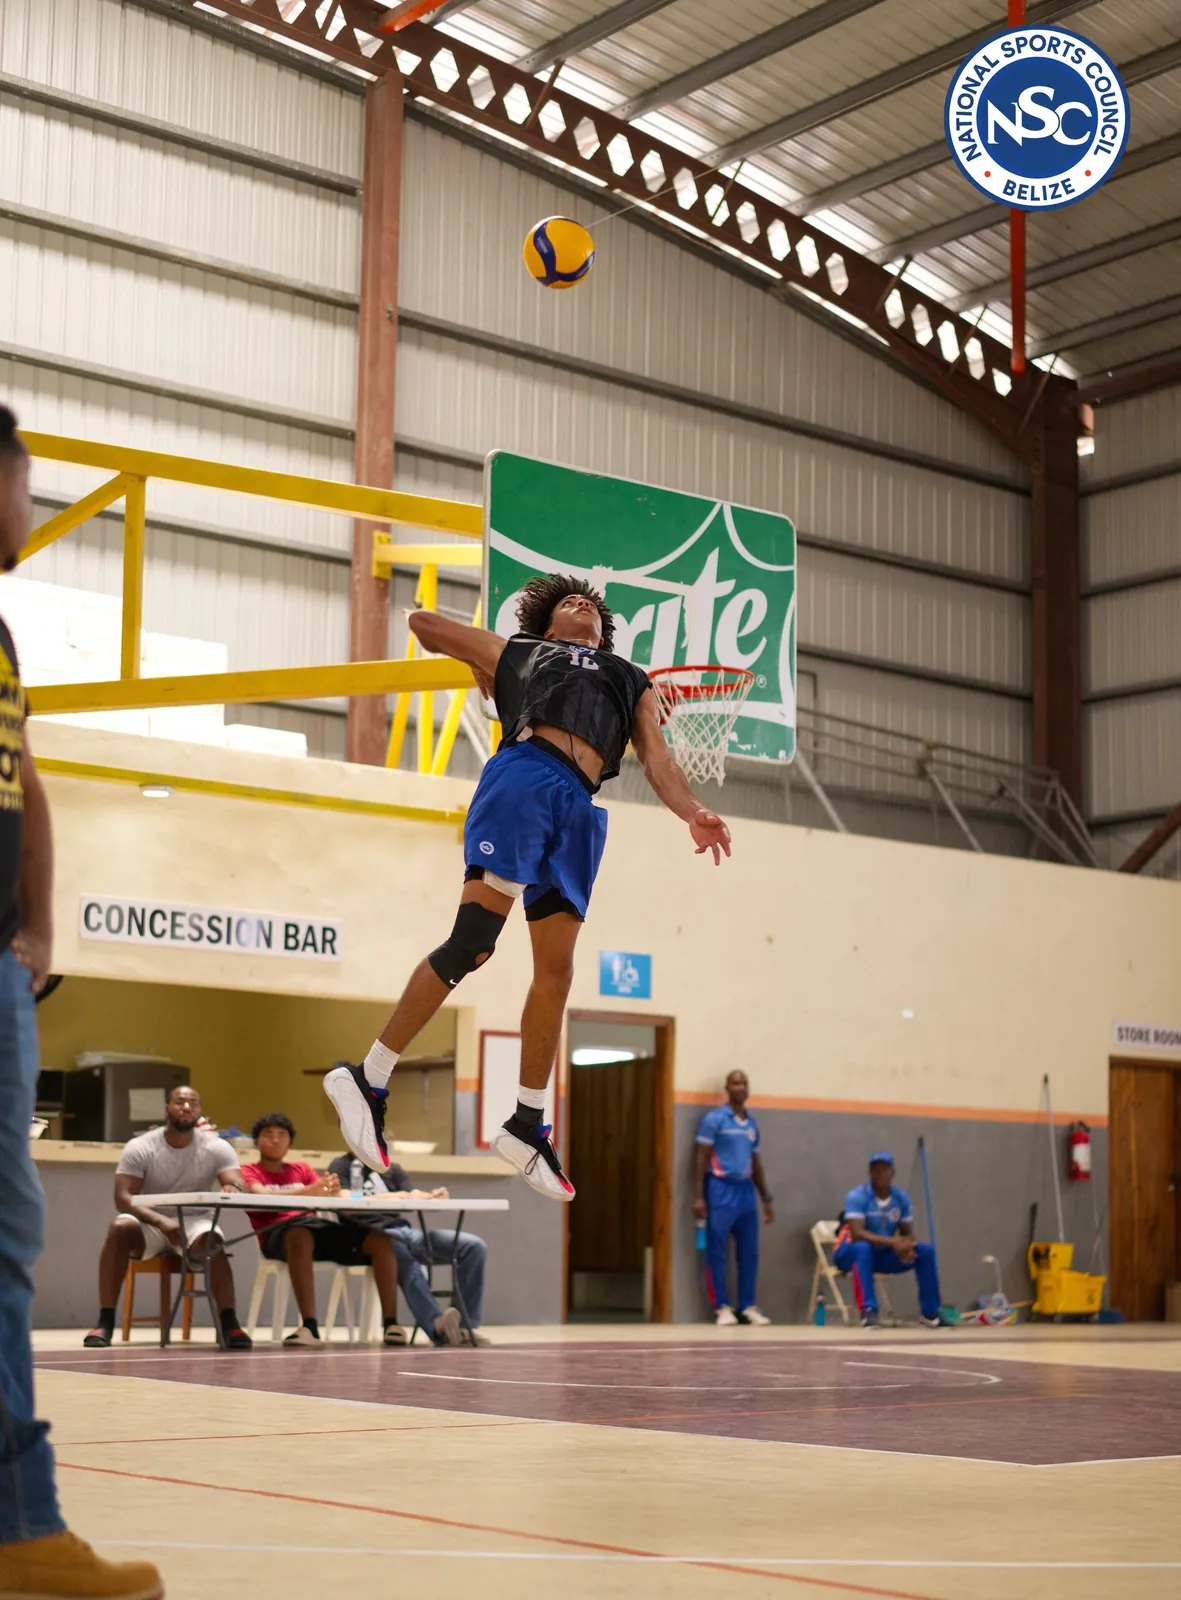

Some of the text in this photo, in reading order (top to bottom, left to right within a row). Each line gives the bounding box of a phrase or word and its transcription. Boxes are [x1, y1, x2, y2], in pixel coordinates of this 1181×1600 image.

[83, 902, 338, 956] CONCESSION BAR
[1117, 1026, 1150, 1045] STORE
